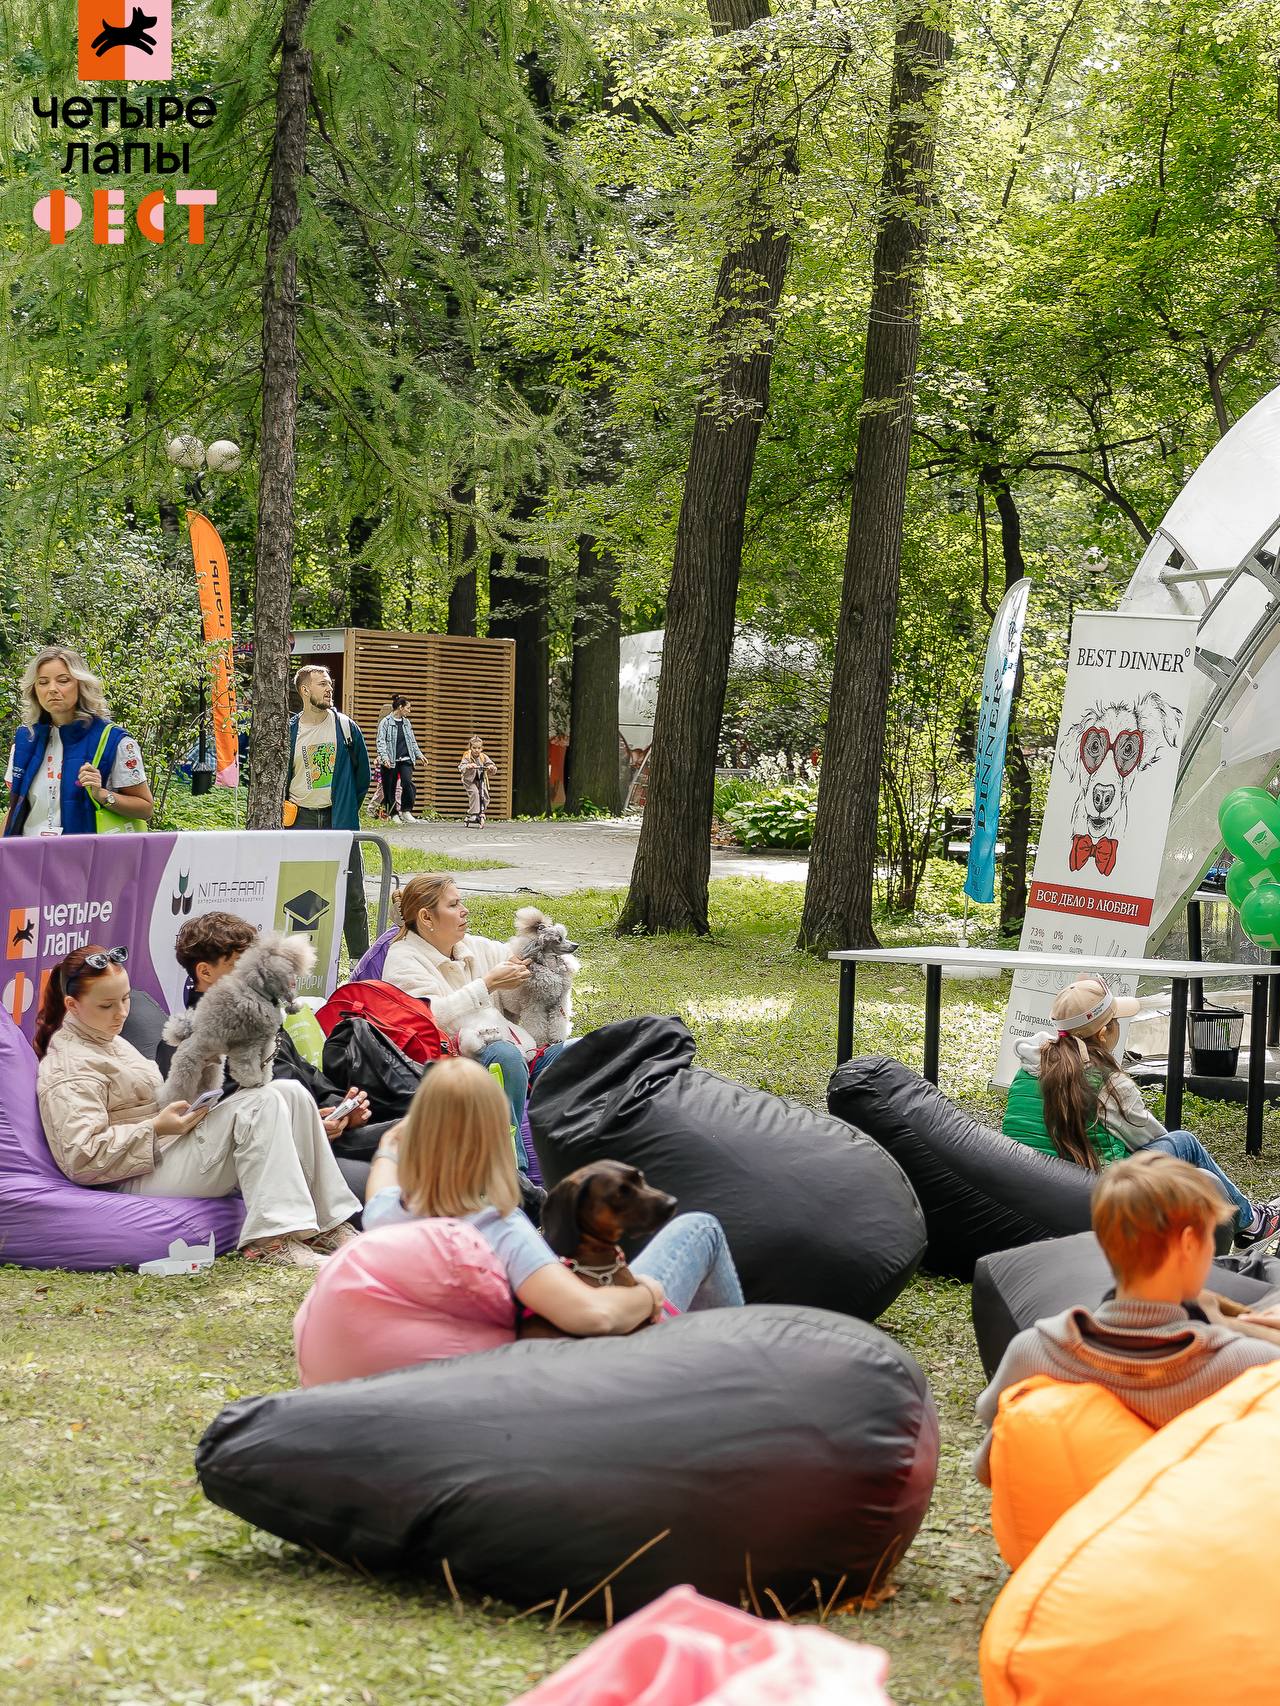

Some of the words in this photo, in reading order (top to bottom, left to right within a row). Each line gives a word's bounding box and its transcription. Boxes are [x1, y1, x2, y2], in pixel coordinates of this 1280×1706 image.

[1076, 647, 1117, 668] BEST
[43, 900, 113, 927] четыре
[1036, 889, 1058, 904] ВСЕ
[1058, 893, 1086, 908] ДЕЛО
[1086, 897, 1094, 909] В
[1096, 899, 1139, 917] ЛЮБВИ!
[42, 930, 90, 957] лапы
[1030, 926, 1045, 938] 73%
[1053, 930, 1064, 941] 0%
